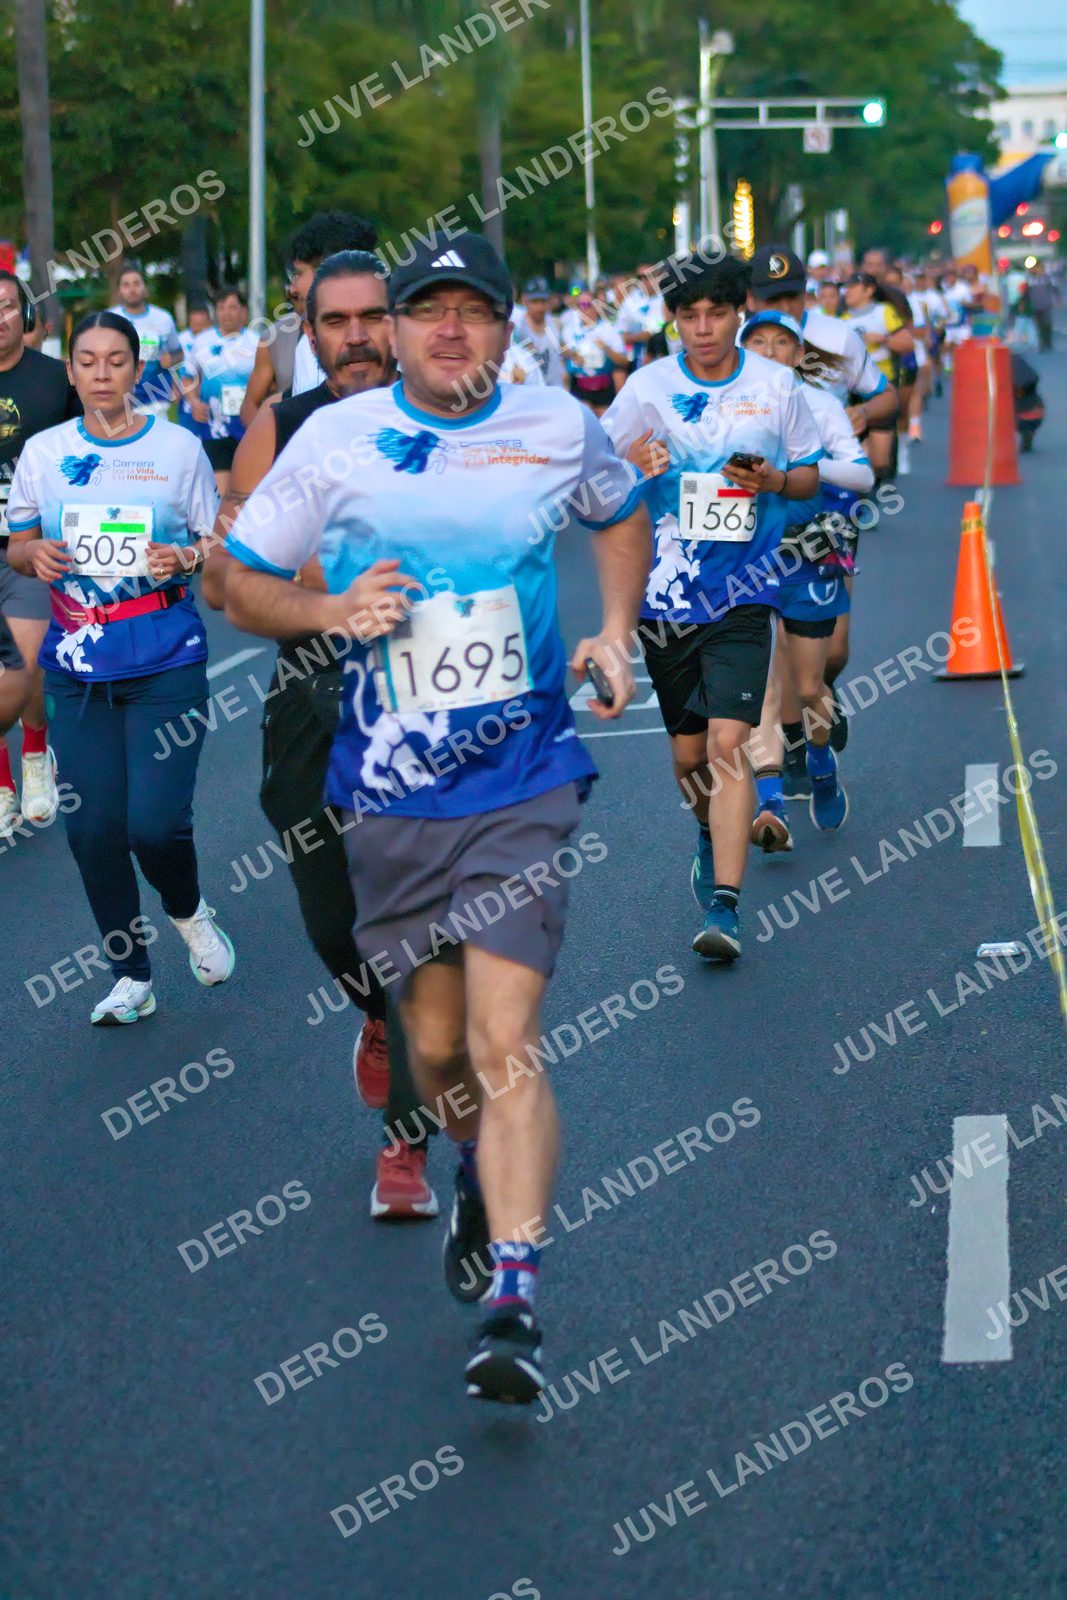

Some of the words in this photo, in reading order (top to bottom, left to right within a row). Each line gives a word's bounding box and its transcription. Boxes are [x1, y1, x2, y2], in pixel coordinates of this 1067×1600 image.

[112, 459, 155, 468] Carrera
[488, 453, 550, 466] Integridad
[136, 467, 155, 475] Vida
[127, 474, 169, 483] Integridad
[686, 501, 757, 531] 1565
[74, 535, 137, 567] 505
[400, 633, 524, 697] 1695
